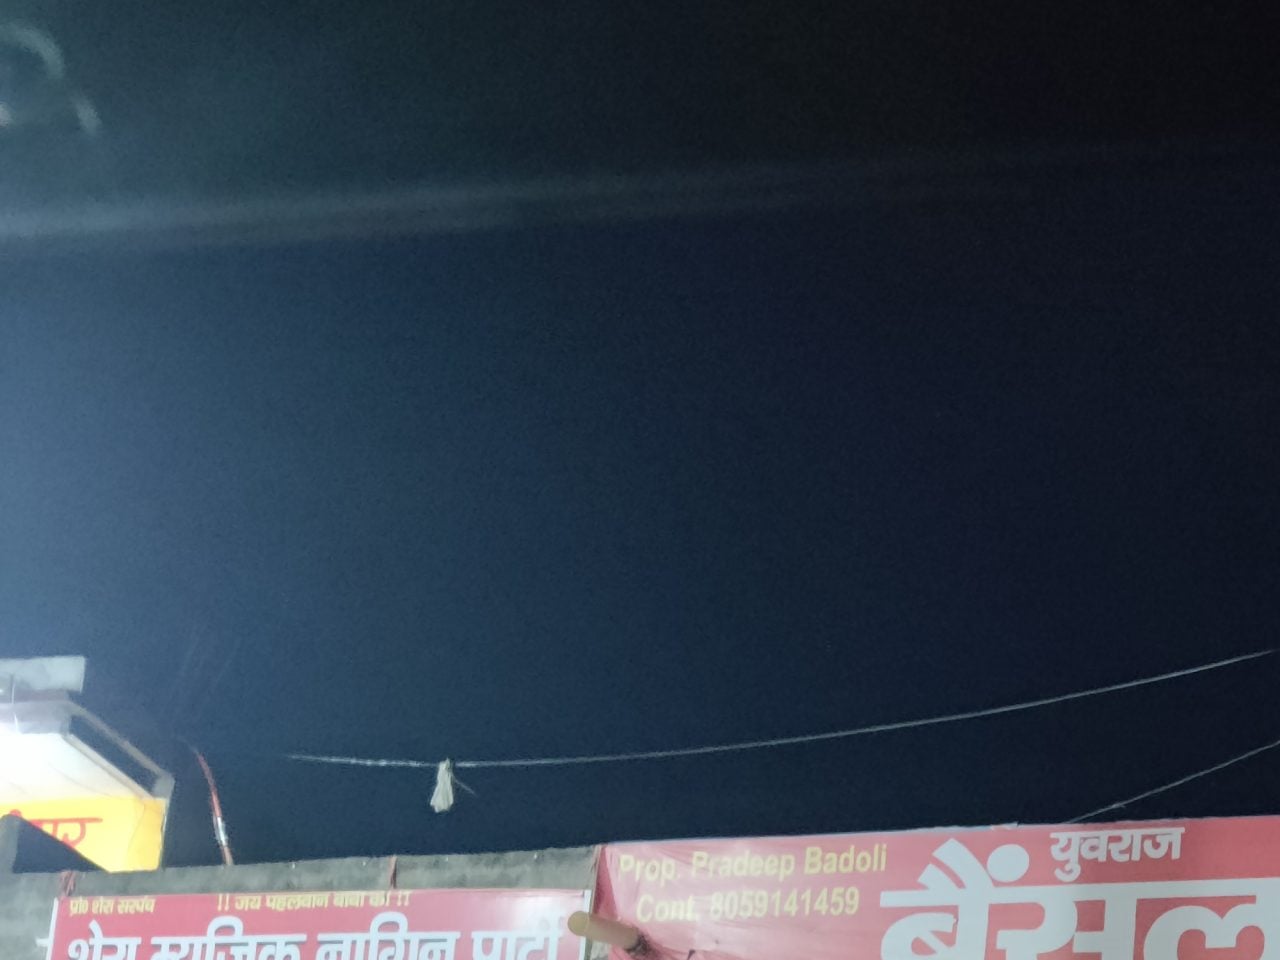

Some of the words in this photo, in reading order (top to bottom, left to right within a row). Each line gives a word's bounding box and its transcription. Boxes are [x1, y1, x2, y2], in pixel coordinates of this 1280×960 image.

[618, 853, 681, 887] Prop.
[691, 850, 796, 882] Pradeep
[803, 843, 887, 875] Badoli
[1050, 827, 1185, 882] युवराज
[636, 894, 700, 923] Cont.
[709, 886, 860, 920] 8059141459
